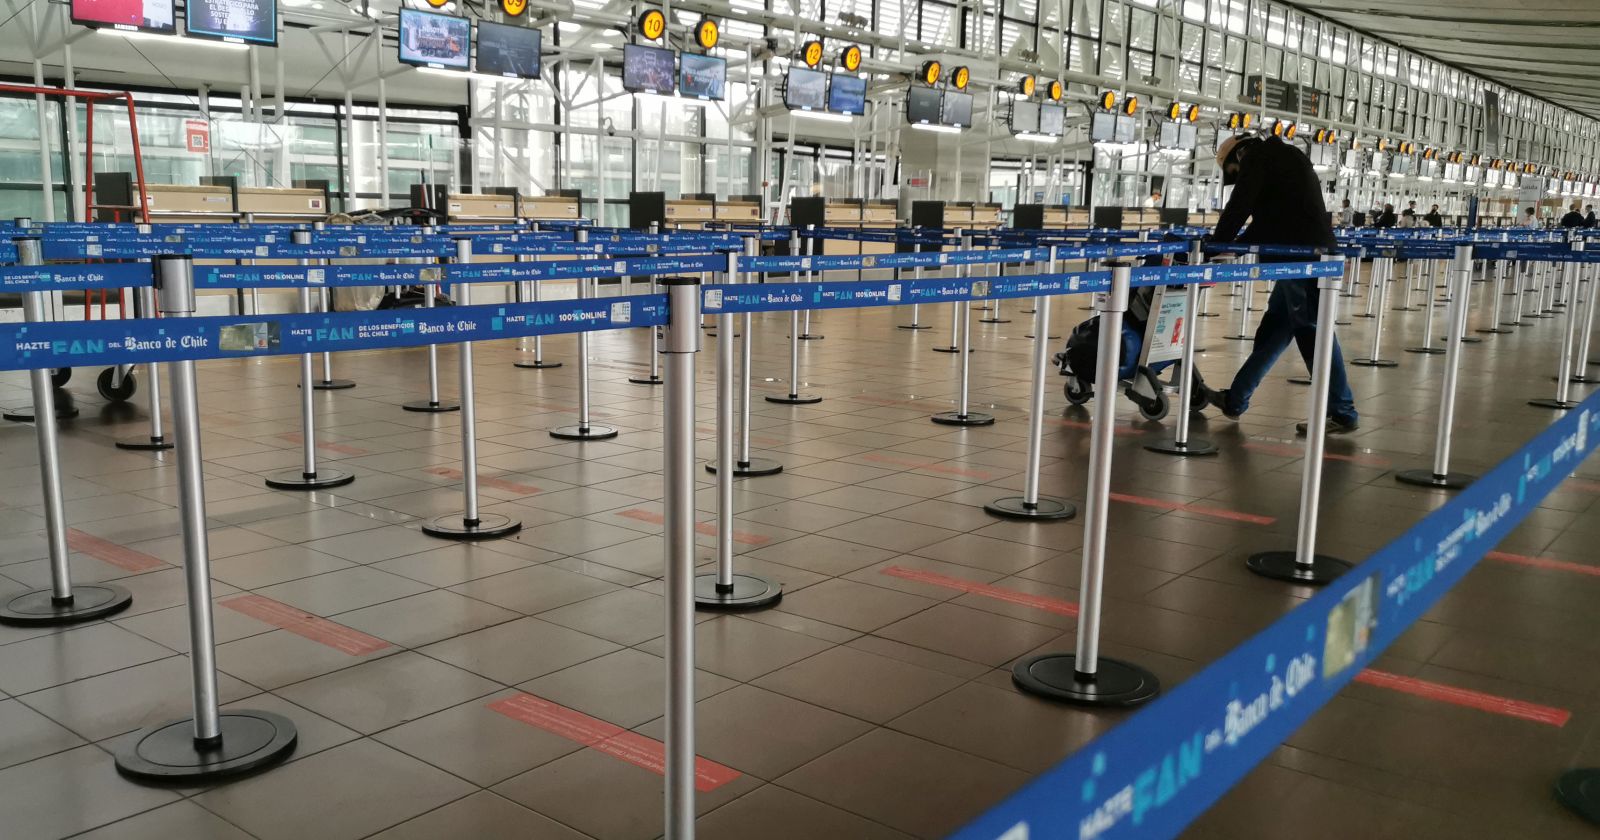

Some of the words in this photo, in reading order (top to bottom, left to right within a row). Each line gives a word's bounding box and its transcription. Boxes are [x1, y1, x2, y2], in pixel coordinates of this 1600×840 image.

[648, 18, 661, 32] 10
[704, 28, 713, 40] 11
[810, 48, 820, 60] 12
[850, 53, 859, 64] 13
[54, 274, 76, 283] Banco
[78, 274, 85, 282] de
[236, 273, 260, 281] FAN
[738, 294, 760, 304] FAN
[767, 293, 784, 303] Banco
[790, 294, 803, 302] Chile
[834, 290, 853, 300] FAN
[920, 288, 936, 297] FAN
[526, 314, 555, 326] FAN
[559, 313, 579, 322] 100%
[580, 311, 607, 320] ONLINE
[419, 322, 444, 334] Banco
[446, 322, 454, 332] de
[457, 320, 477, 331] Chile
[316, 327, 355, 341] FAN
[16, 341, 51, 350] HAZTE
[52, 339, 104, 355] FAN
[125, 336, 162, 350] Banco
[165, 336, 177, 348] de
[180, 335, 208, 348] Chile
[1080, 784, 1134, 840] HAZTE
[1132, 731, 1202, 826] FAN
[1224, 699, 1269, 745] Banco
[1269, 675, 1284, 710] de
[1285, 653, 1316, 697] Chile
